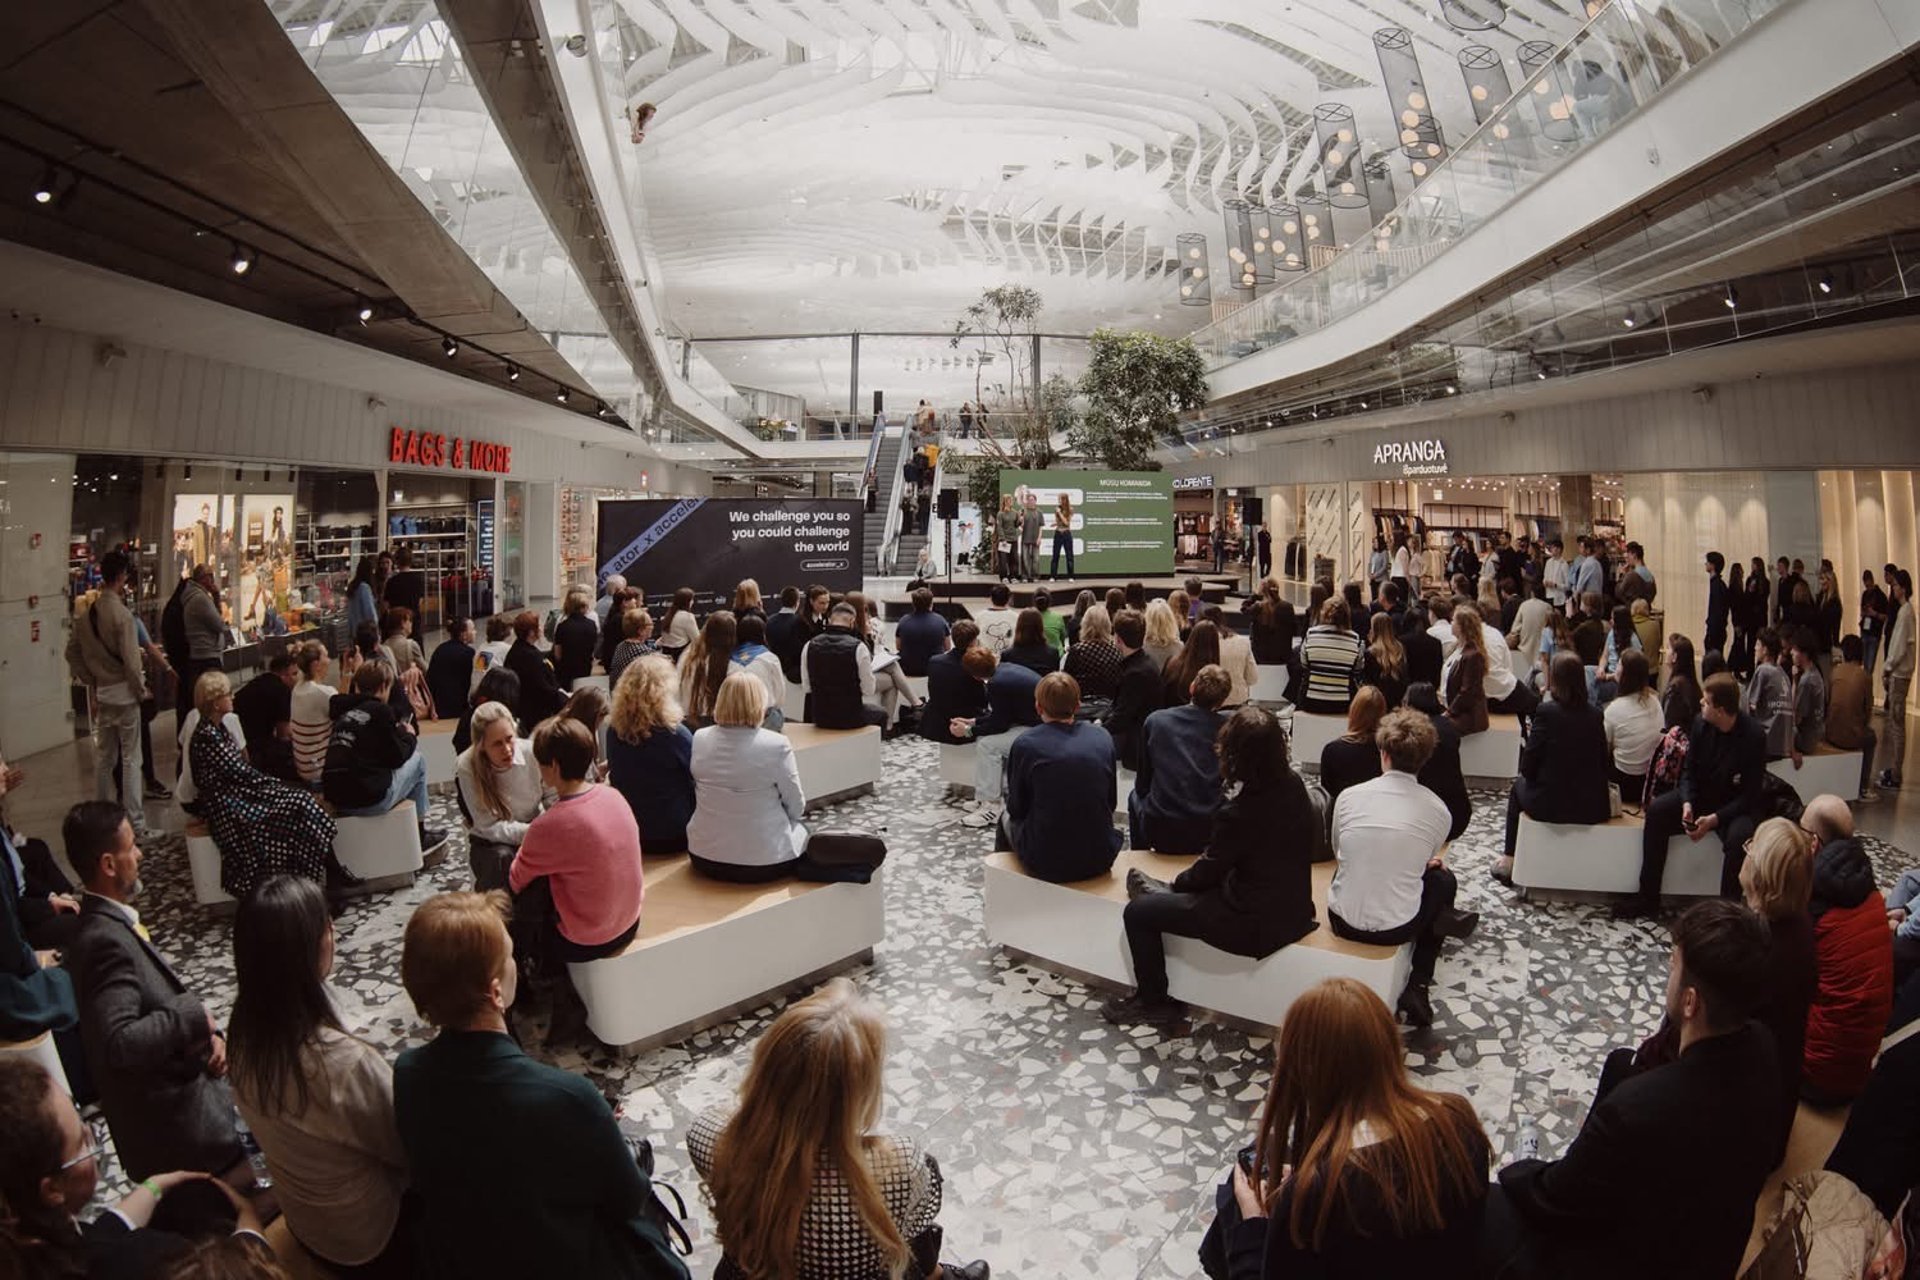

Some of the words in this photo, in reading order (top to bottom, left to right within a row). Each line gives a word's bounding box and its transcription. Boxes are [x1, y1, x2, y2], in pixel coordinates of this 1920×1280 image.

[389, 426, 446, 467] BAGS
[451, 437, 464, 469] &
[470, 439, 512, 474] MORE
[1374, 440, 1445, 464] APRANGA
[729, 511, 750, 522] We
[752, 510, 810, 523] challenge
[813, 513, 834, 523] you
[836, 513, 850, 521] so
[732, 529, 755, 540] you
[758, 526, 792, 538] could
[794, 525, 850, 538] challenge
[794, 541, 814, 552] the
[817, 540, 850, 551] world
